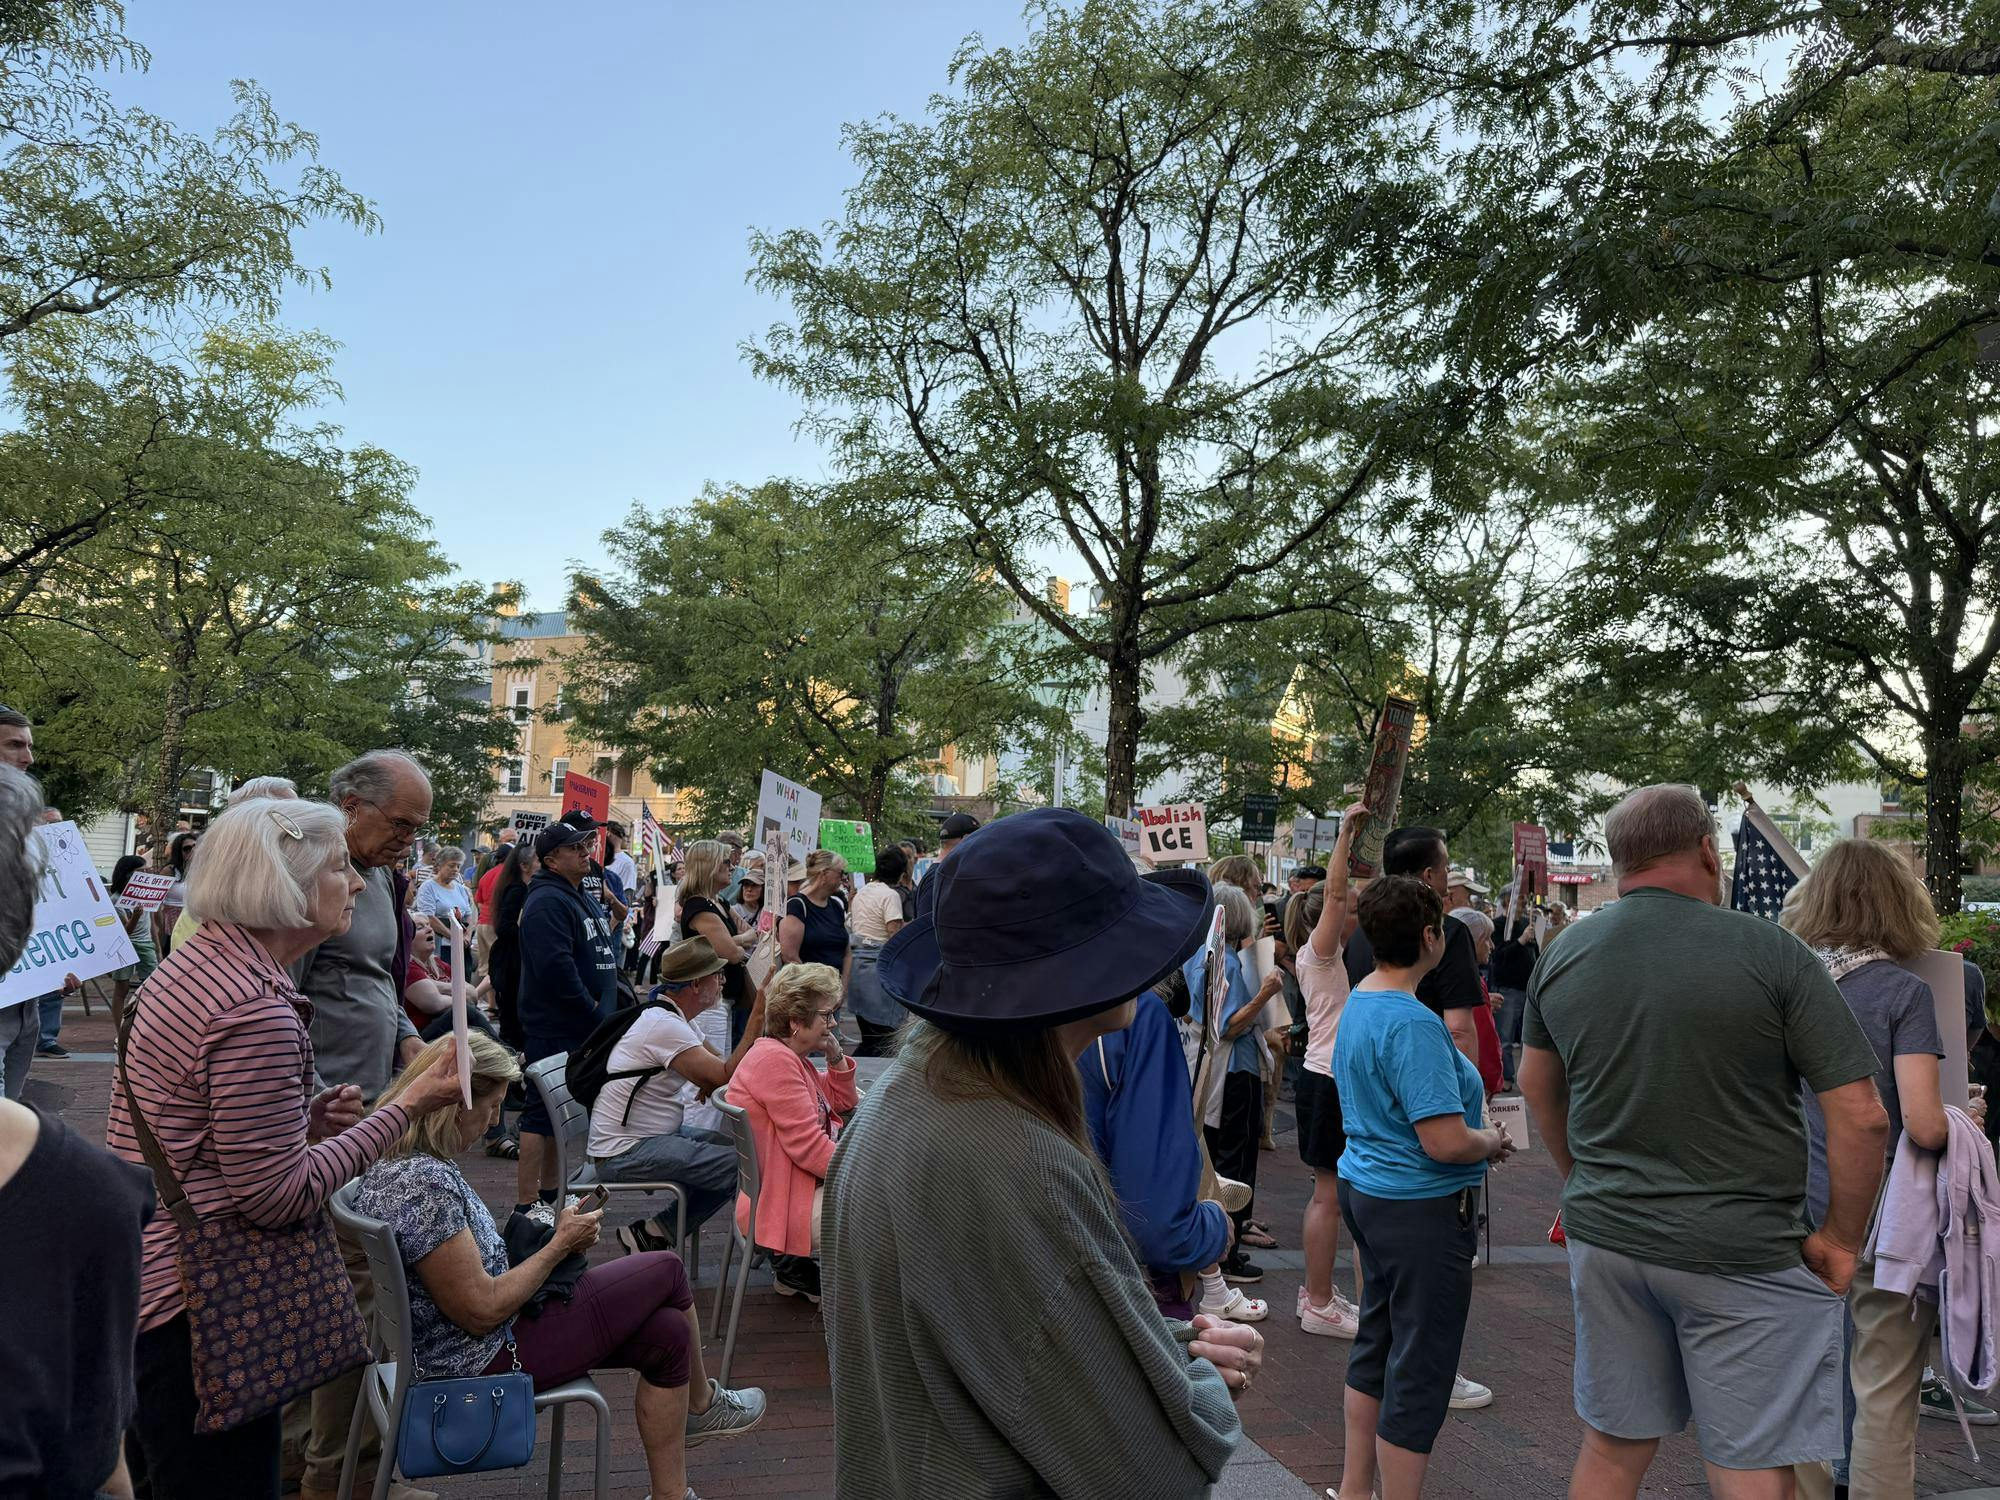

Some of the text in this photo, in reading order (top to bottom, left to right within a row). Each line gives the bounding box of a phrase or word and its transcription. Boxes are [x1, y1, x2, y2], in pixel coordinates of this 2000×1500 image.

[776, 781, 800, 804] WHAT
[516, 813, 547, 823] HANDS
[786, 805, 798, 822] AN
[1138, 806, 1202, 827] Abolish
[515, 820, 546, 832] OFF!
[790, 827, 812, 851] ASS!
[1148, 827, 1193, 852] ICE
[125, 885, 167, 900] PROPERTY
[1488, 1105, 1520, 1113] ORKERS
